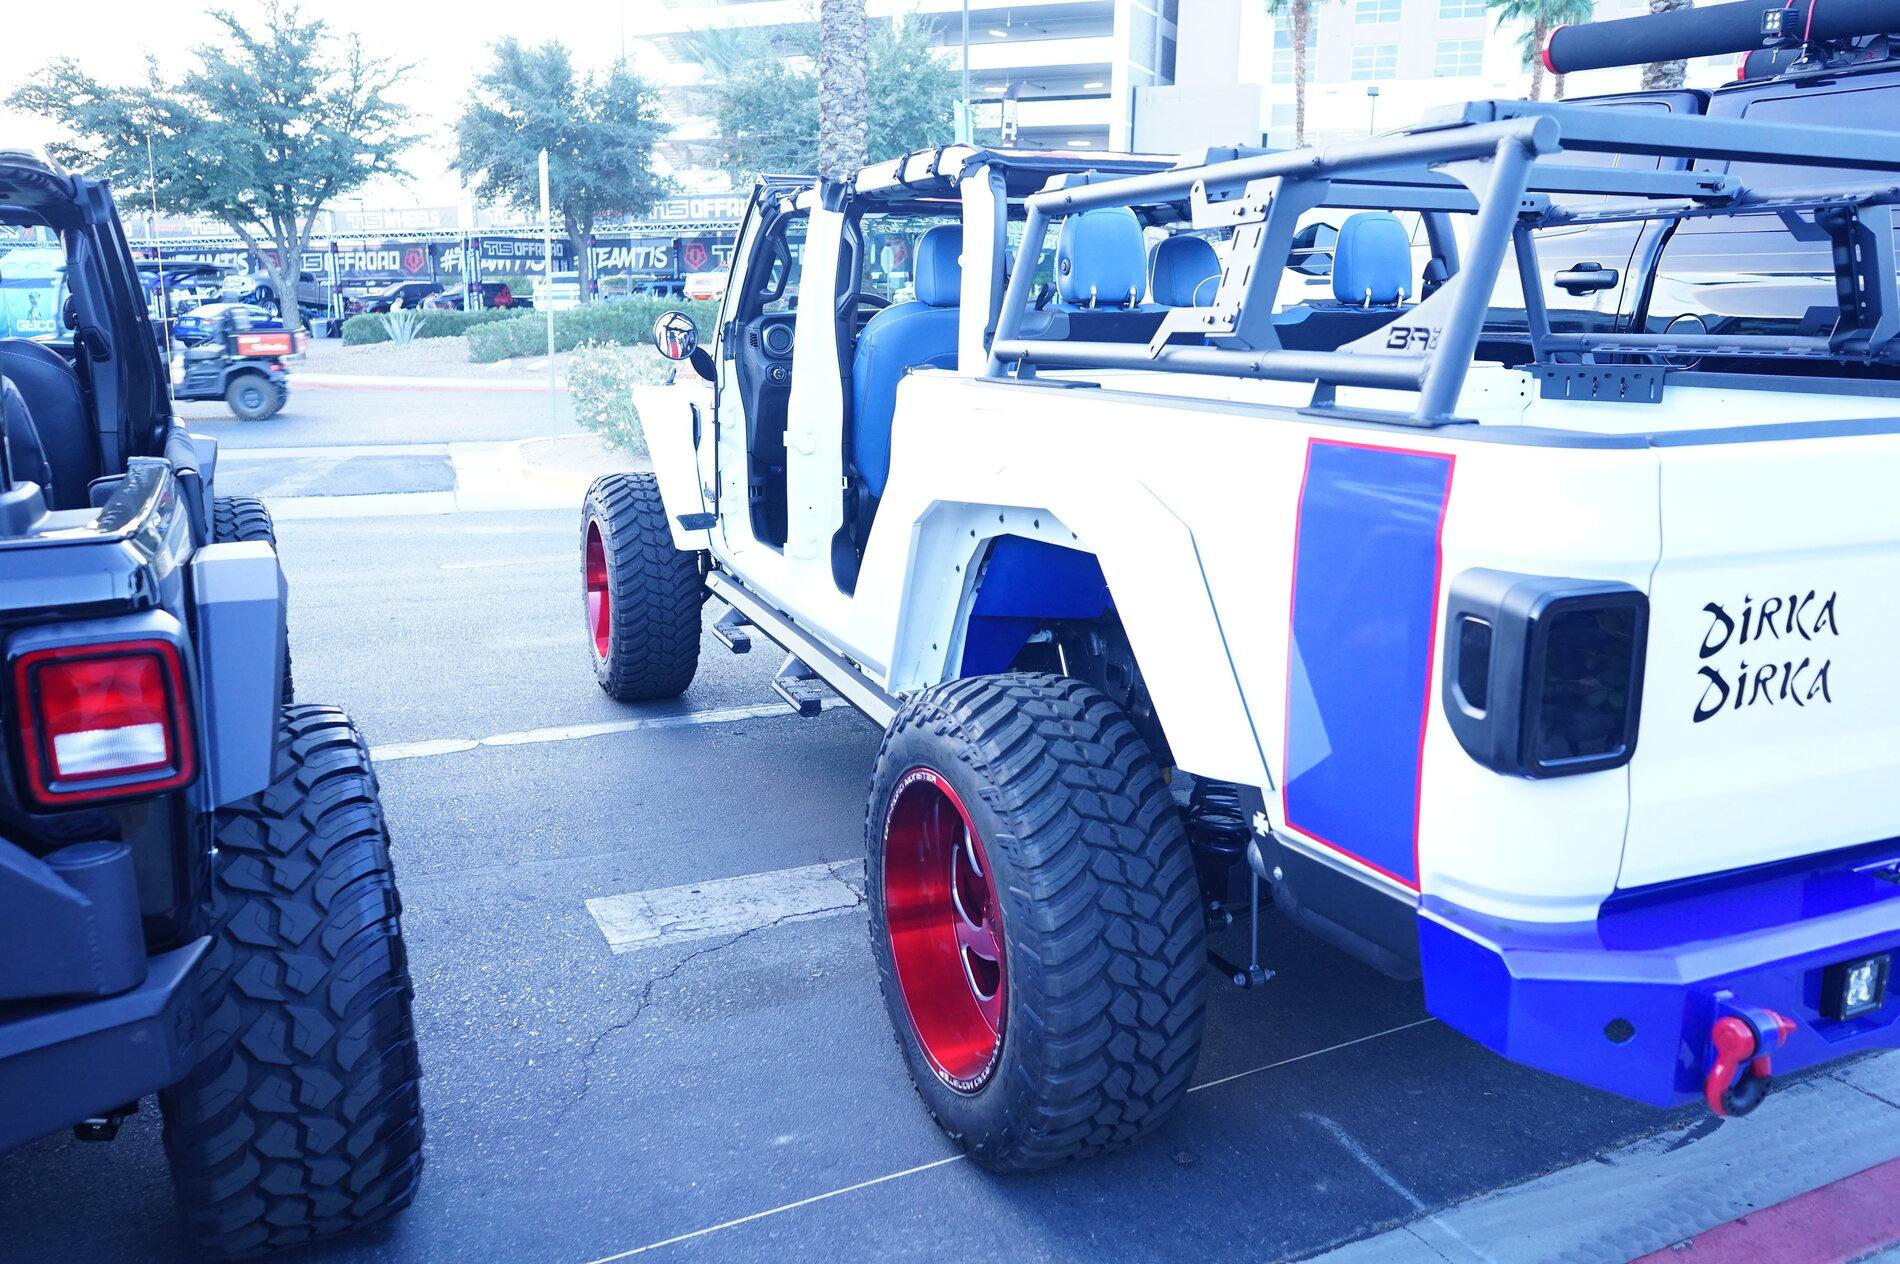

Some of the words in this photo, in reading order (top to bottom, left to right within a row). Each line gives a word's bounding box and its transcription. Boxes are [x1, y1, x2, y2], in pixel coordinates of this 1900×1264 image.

[483, 241, 514, 256] TIS
[514, 242, 563, 257] OFFRAD
[16, 319, 57, 332] GEICO
